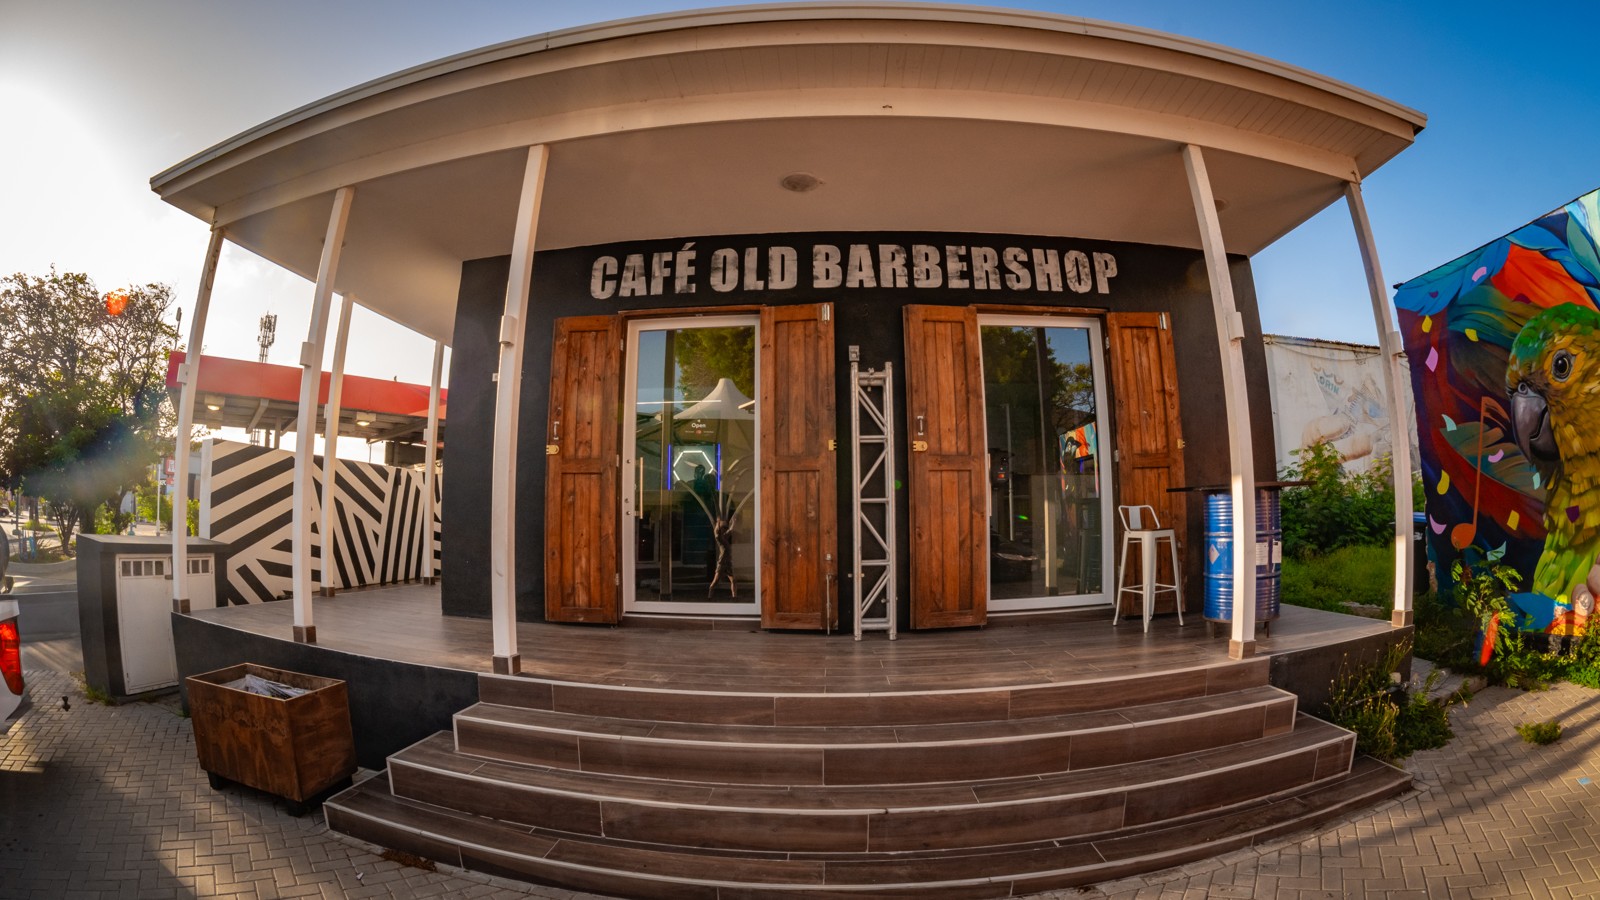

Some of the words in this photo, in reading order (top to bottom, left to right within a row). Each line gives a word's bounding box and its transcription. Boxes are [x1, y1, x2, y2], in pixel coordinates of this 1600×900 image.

[590, 242, 697, 300] CAFÉ
[710, 246, 798, 293] OLD
[812, 244, 1118, 294] BARBERSHOP
